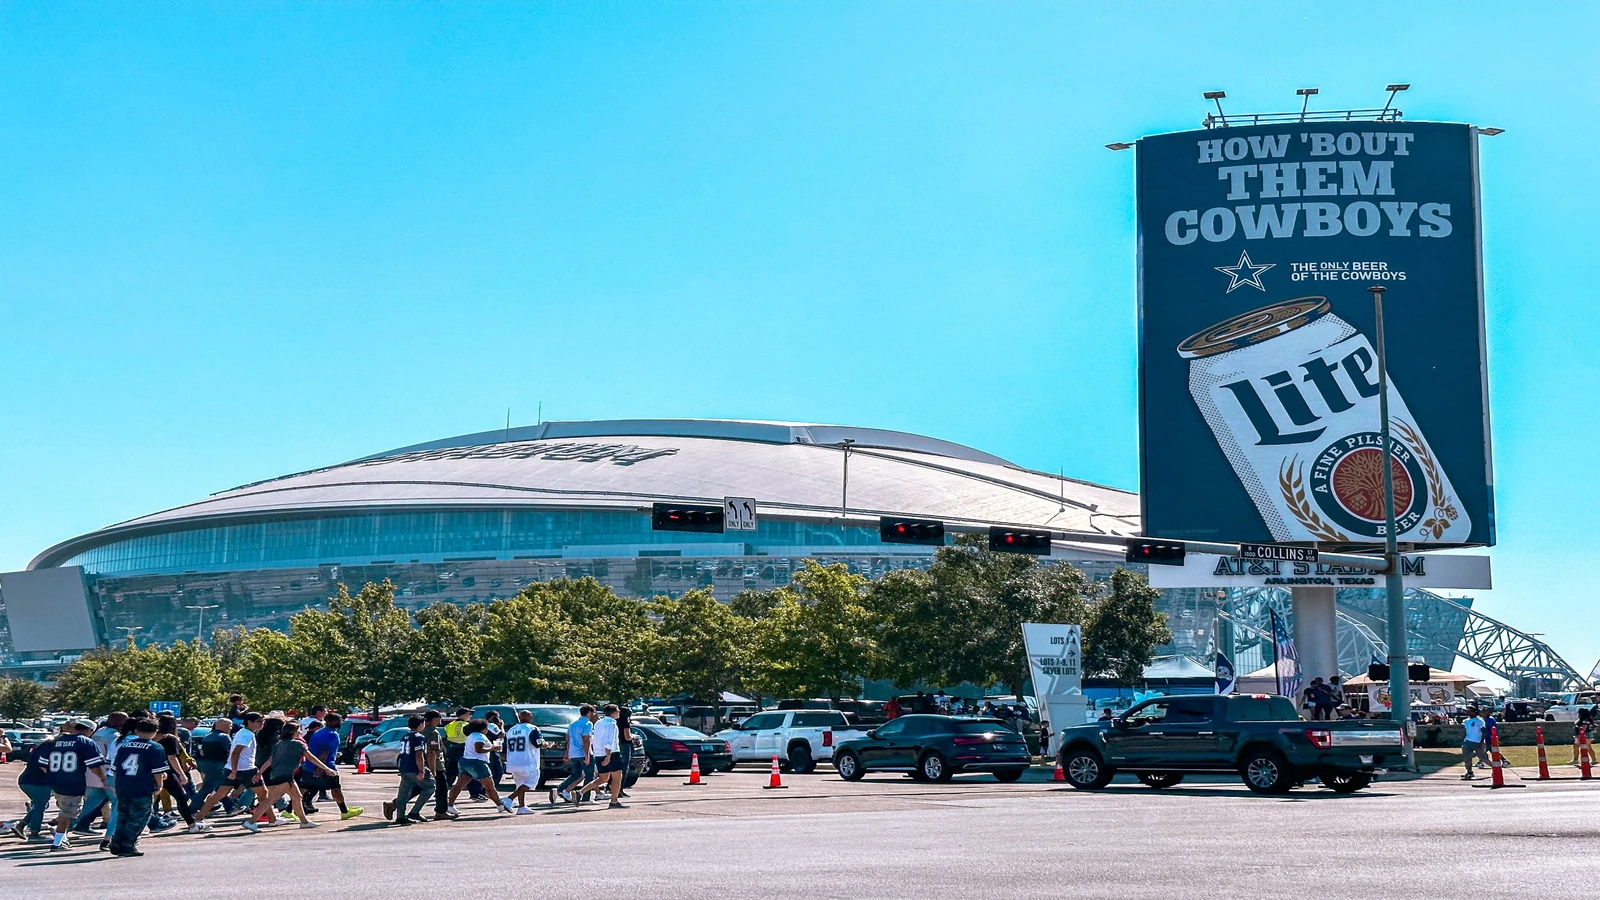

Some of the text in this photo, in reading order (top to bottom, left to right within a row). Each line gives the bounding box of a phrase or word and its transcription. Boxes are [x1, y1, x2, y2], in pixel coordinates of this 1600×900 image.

[1197, 132, 1414, 164] HOW 'BOUT
[1218, 160, 1395, 200] THEM
[1164, 201, 1453, 246] COWBOYS
[1290, 261, 1388, 272] THE ONLY BEER
[1291, 271, 1407, 281] OF THE COWBOYS
[1219, 346, 1381, 445] Lite
[1314, 446, 1343, 480] FINE
[1315, 483, 1328, 494] A
[728, 520, 739, 528] ONLY
[1257, 546, 1304, 561] COLLINS
[1213, 556, 1284, 576] AT&T
[1264, 577, 1376, 585] ARLINGTON, TEXAS
[1050, 636, 1065, 645] LOTS
[1040, 658, 1055, 666] LOTS
[1042, 667, 1077, 675] SILVER LOTS
[49, 751, 78, 773] 88
[121, 753, 139, 776] 4
